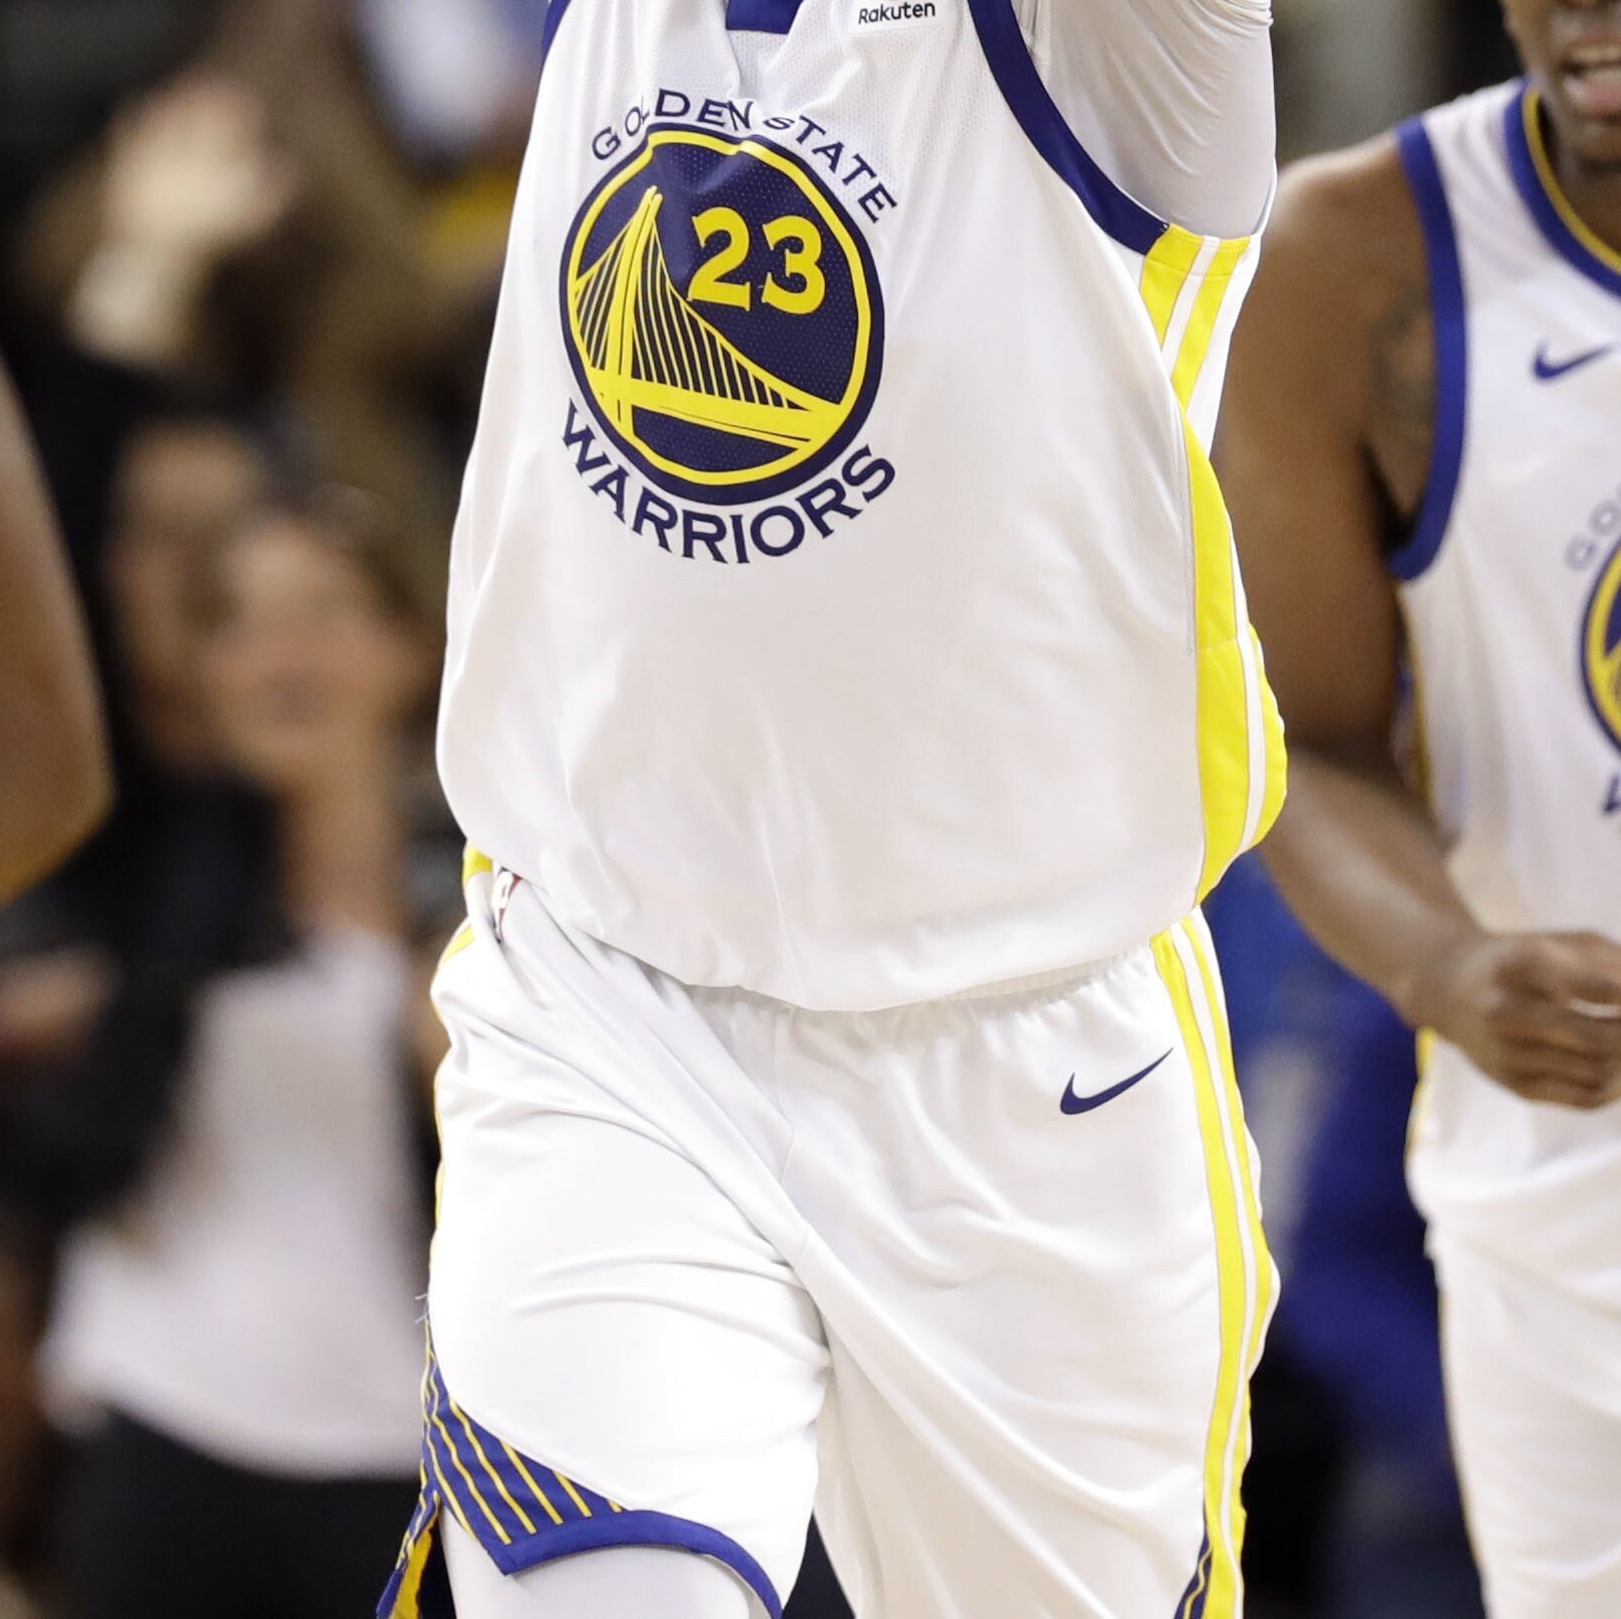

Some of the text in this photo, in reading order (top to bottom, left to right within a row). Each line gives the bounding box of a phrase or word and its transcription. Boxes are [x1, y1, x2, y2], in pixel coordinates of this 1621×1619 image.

[857, 1, 936, 25] Rakuten
[591, 86, 898, 223] GOLDEN STATE
[686, 206, 826, 316] 23
[562, 396, 897, 565] WARRIORS
